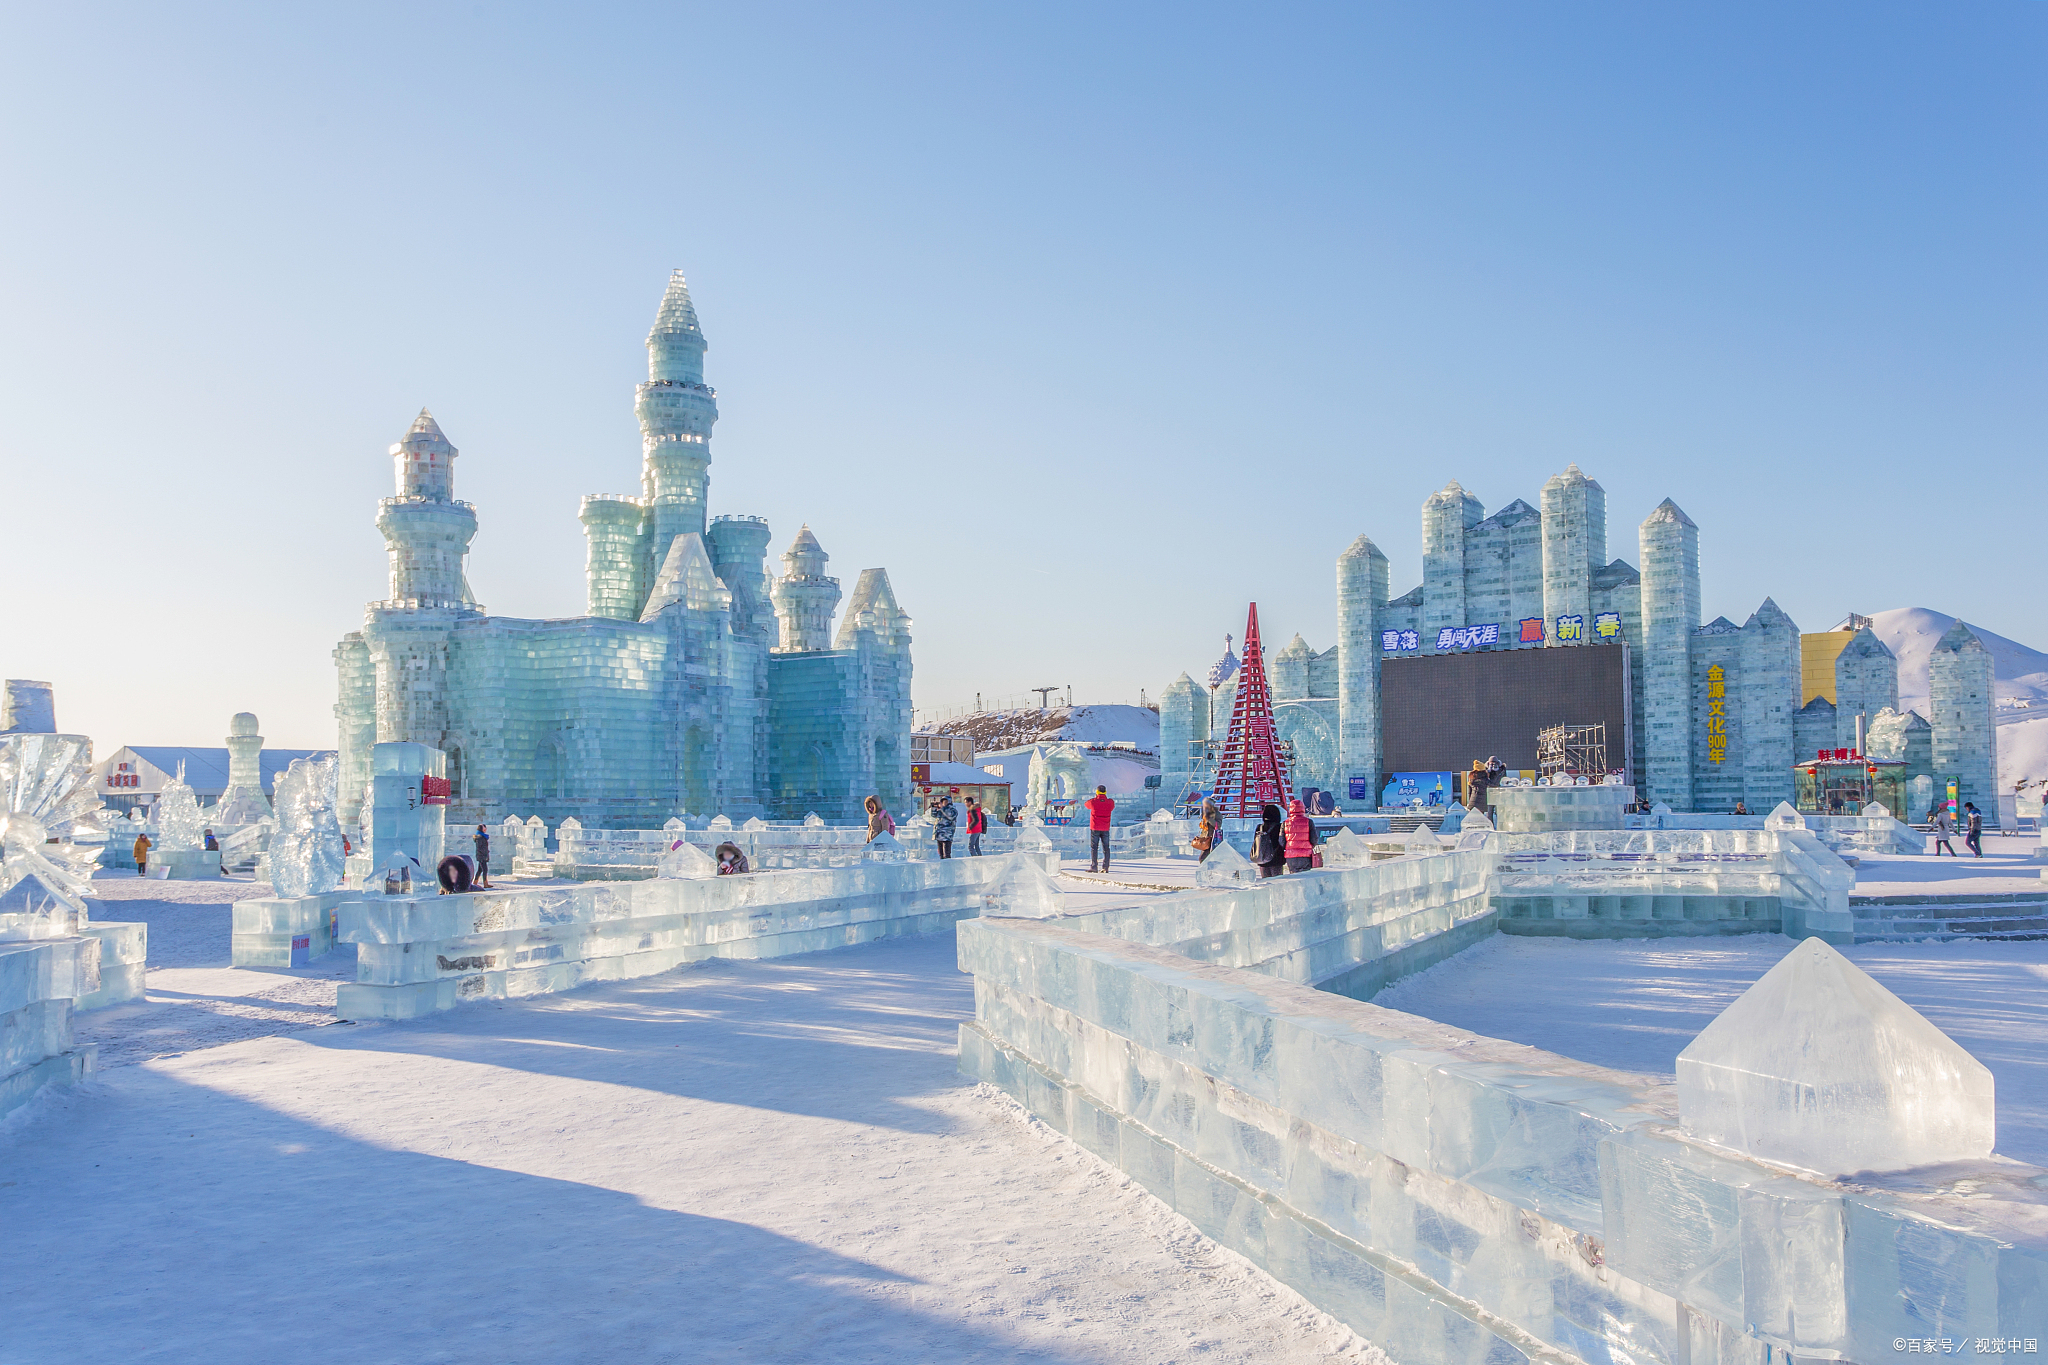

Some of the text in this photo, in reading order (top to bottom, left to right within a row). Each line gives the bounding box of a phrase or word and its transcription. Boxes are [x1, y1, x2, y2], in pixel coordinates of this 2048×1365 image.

[1382, 630, 1419, 650] 雪花
[1436, 623, 1499, 650] 勇闯天涯
[1707, 664, 1726, 765] 金源文化900年
